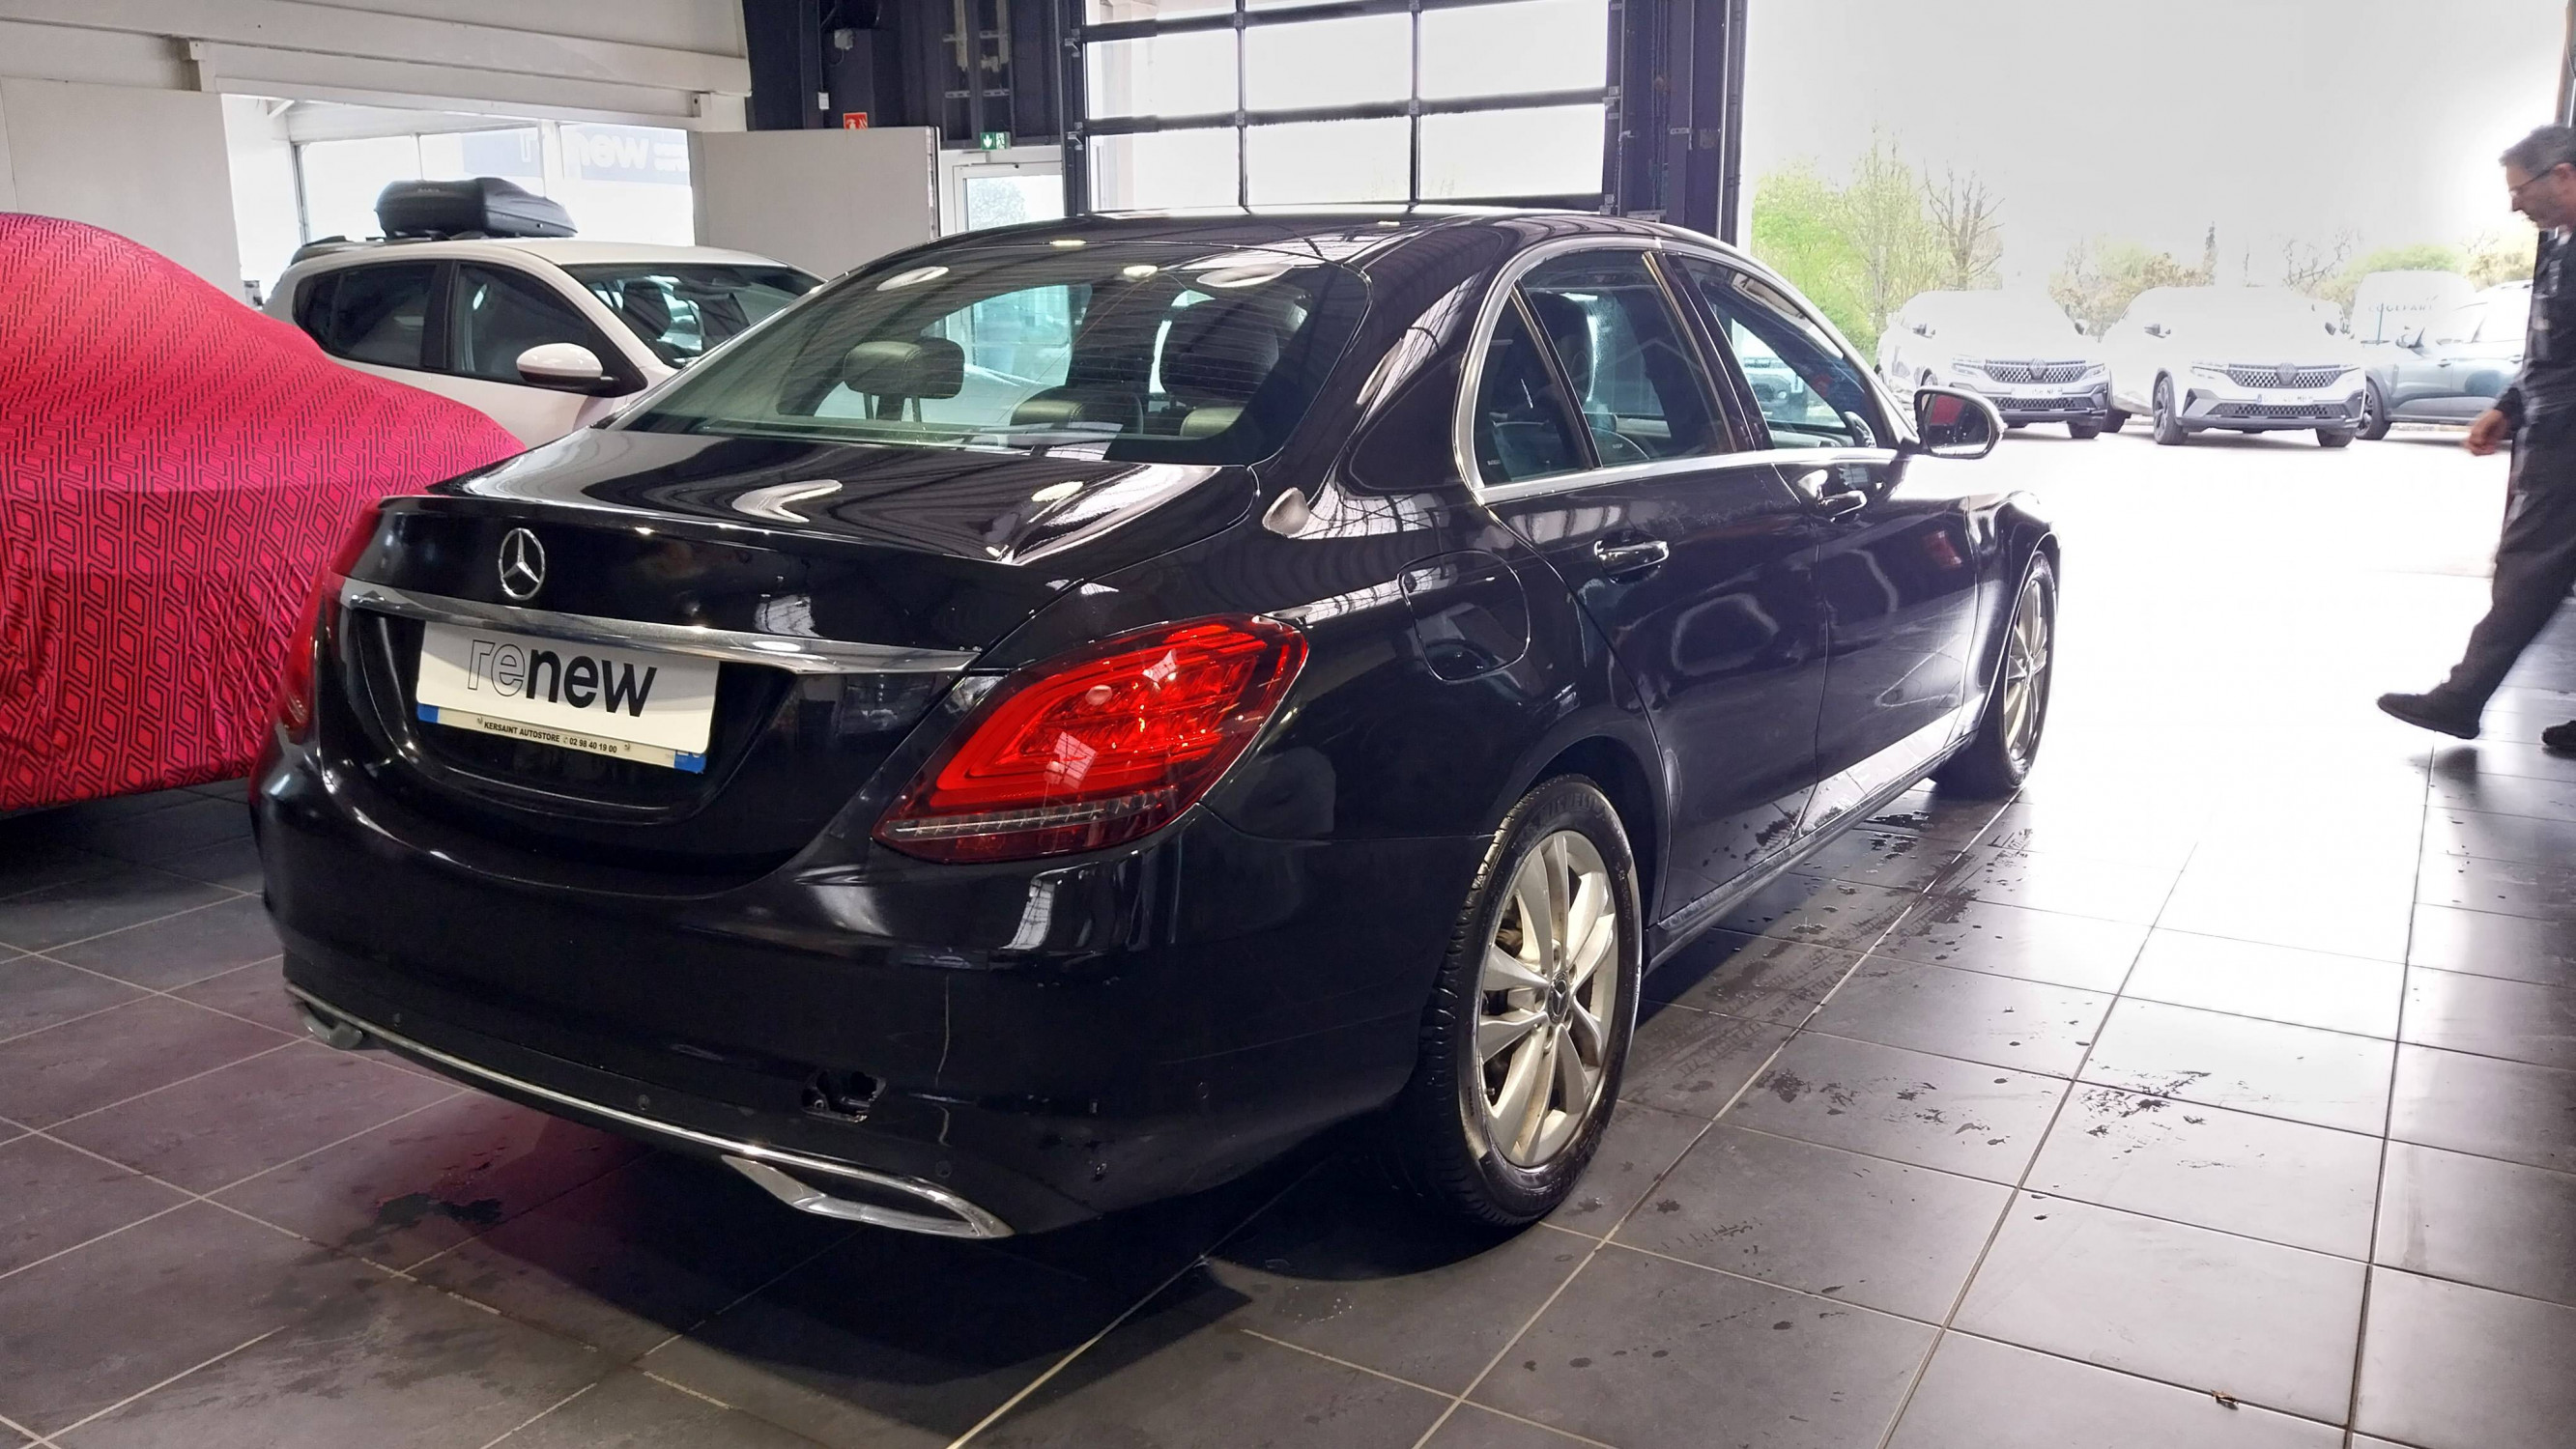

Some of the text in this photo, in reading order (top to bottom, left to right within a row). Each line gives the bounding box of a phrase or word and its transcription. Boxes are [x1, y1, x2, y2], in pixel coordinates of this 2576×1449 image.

[468, 639, 657, 717] renew
[484, 722, 617, 753] KERSAINT AUTOSTORE 02 98 40 19 00
